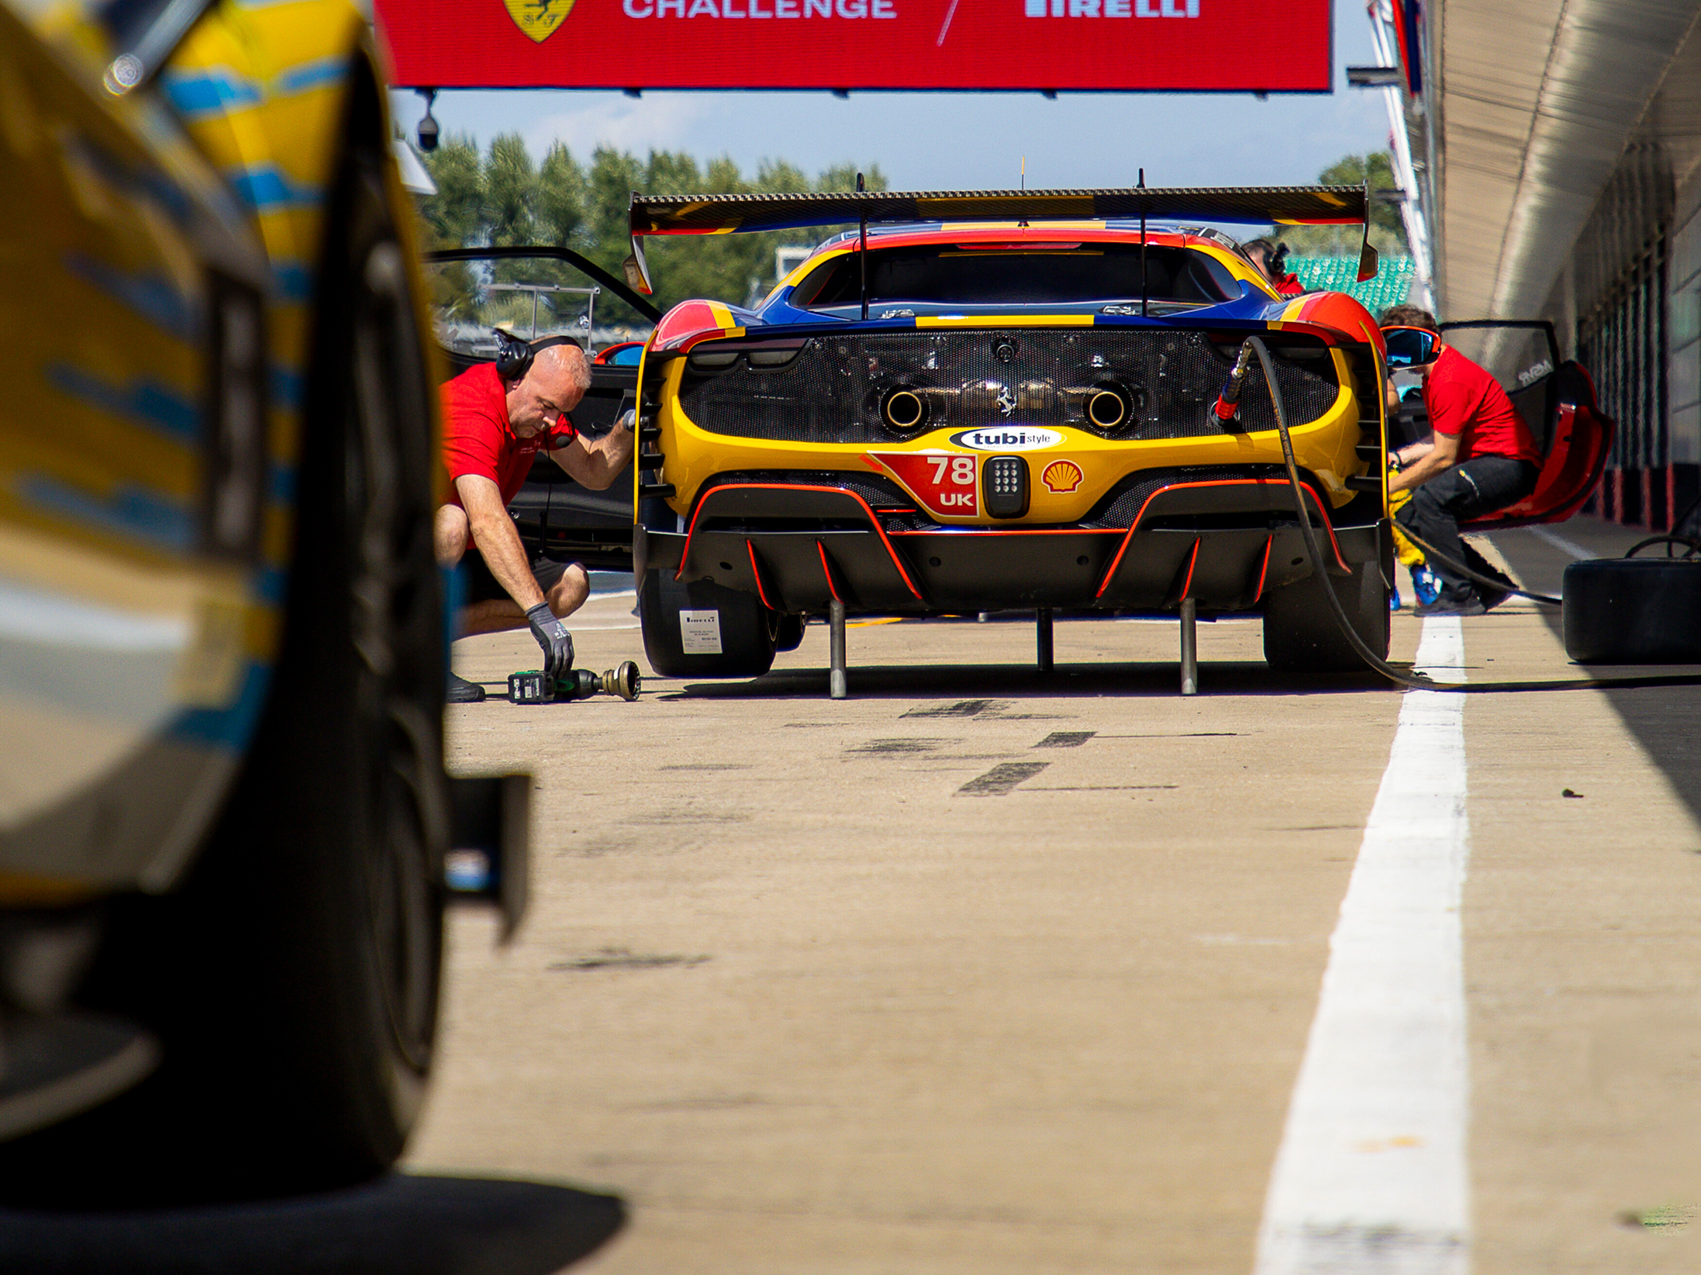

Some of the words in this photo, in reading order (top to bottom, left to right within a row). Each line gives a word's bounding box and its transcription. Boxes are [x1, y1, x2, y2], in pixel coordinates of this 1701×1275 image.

[973, 433, 1025, 445] tubi
[1027, 435, 1050, 444] style
[927, 457, 974, 485] 78
[940, 493, 974, 506] UK
